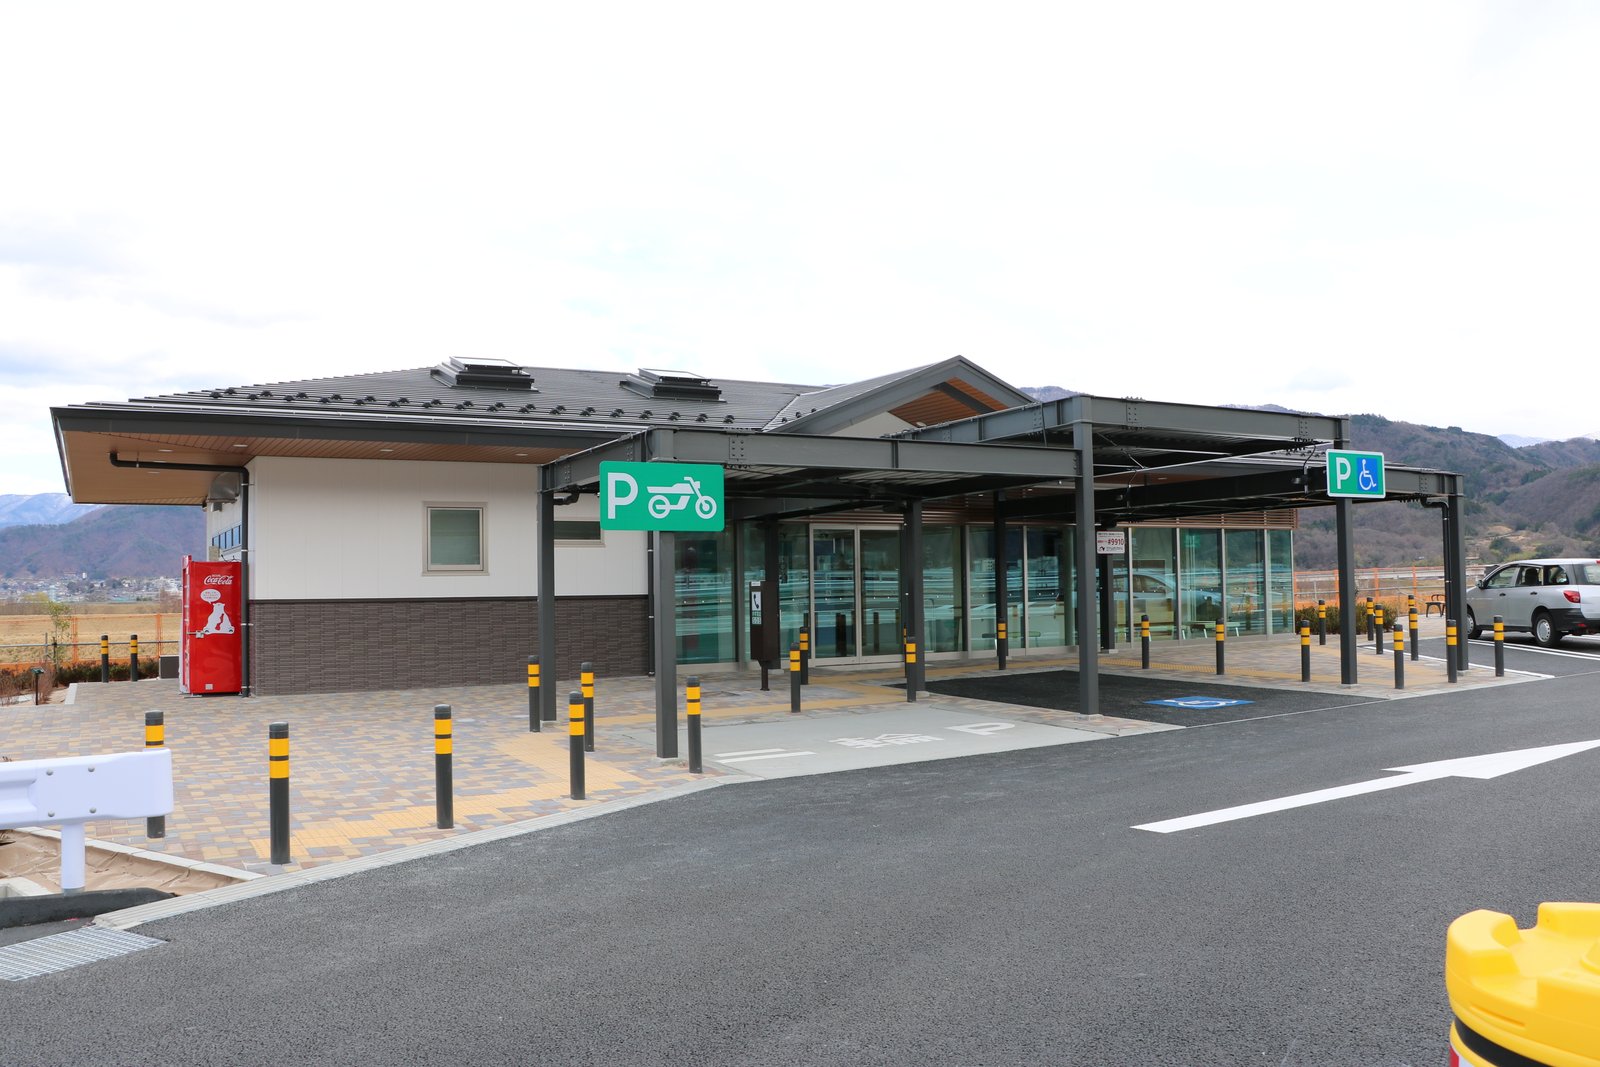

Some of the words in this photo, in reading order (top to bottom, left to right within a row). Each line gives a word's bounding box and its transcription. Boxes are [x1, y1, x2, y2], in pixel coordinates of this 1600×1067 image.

[1336, 457, 1351, 489] P
[608, 472, 638, 519] P
[204, 575, 233, 585] Coca-Cola
